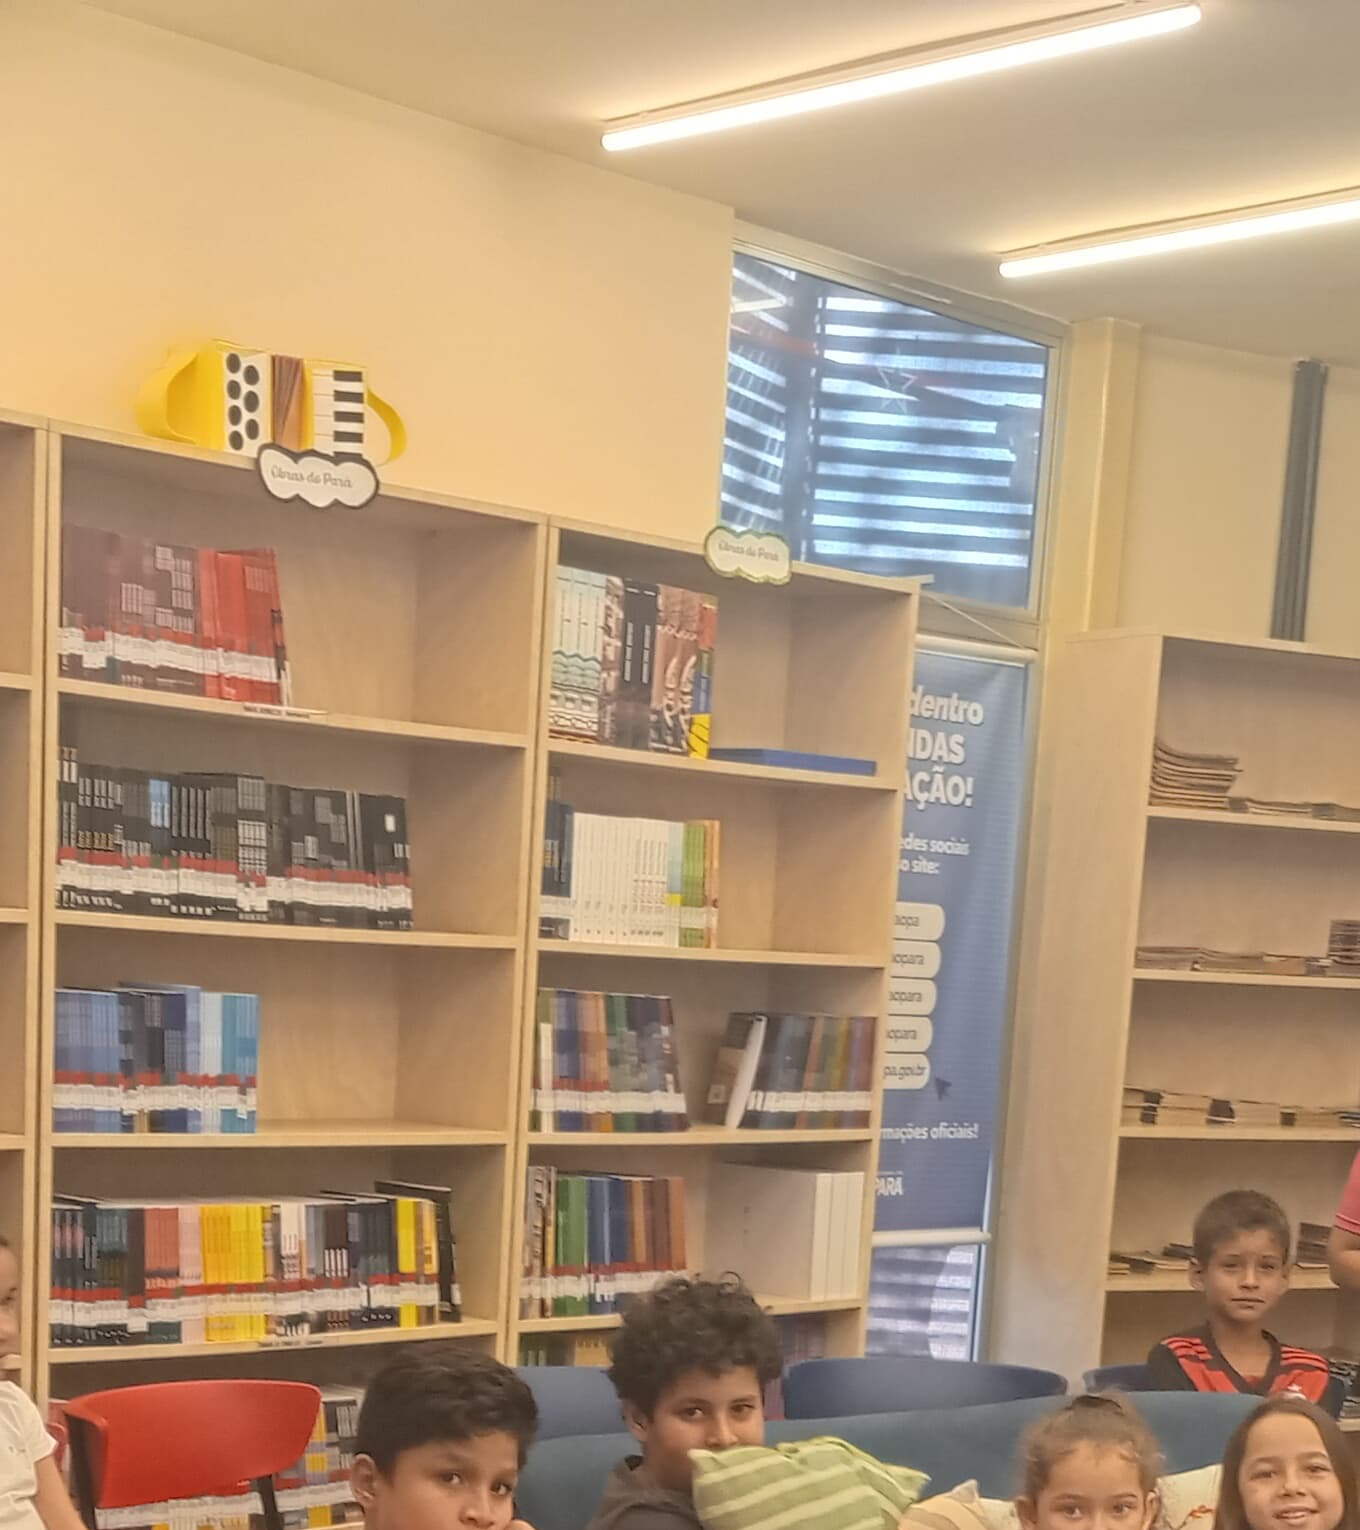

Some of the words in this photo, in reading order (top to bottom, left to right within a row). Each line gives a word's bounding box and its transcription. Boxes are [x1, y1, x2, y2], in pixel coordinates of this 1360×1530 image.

[271, 464, 305, 483] Obras
[306, 471, 321, 485] de
[910, 685, 984, 725] dentro
